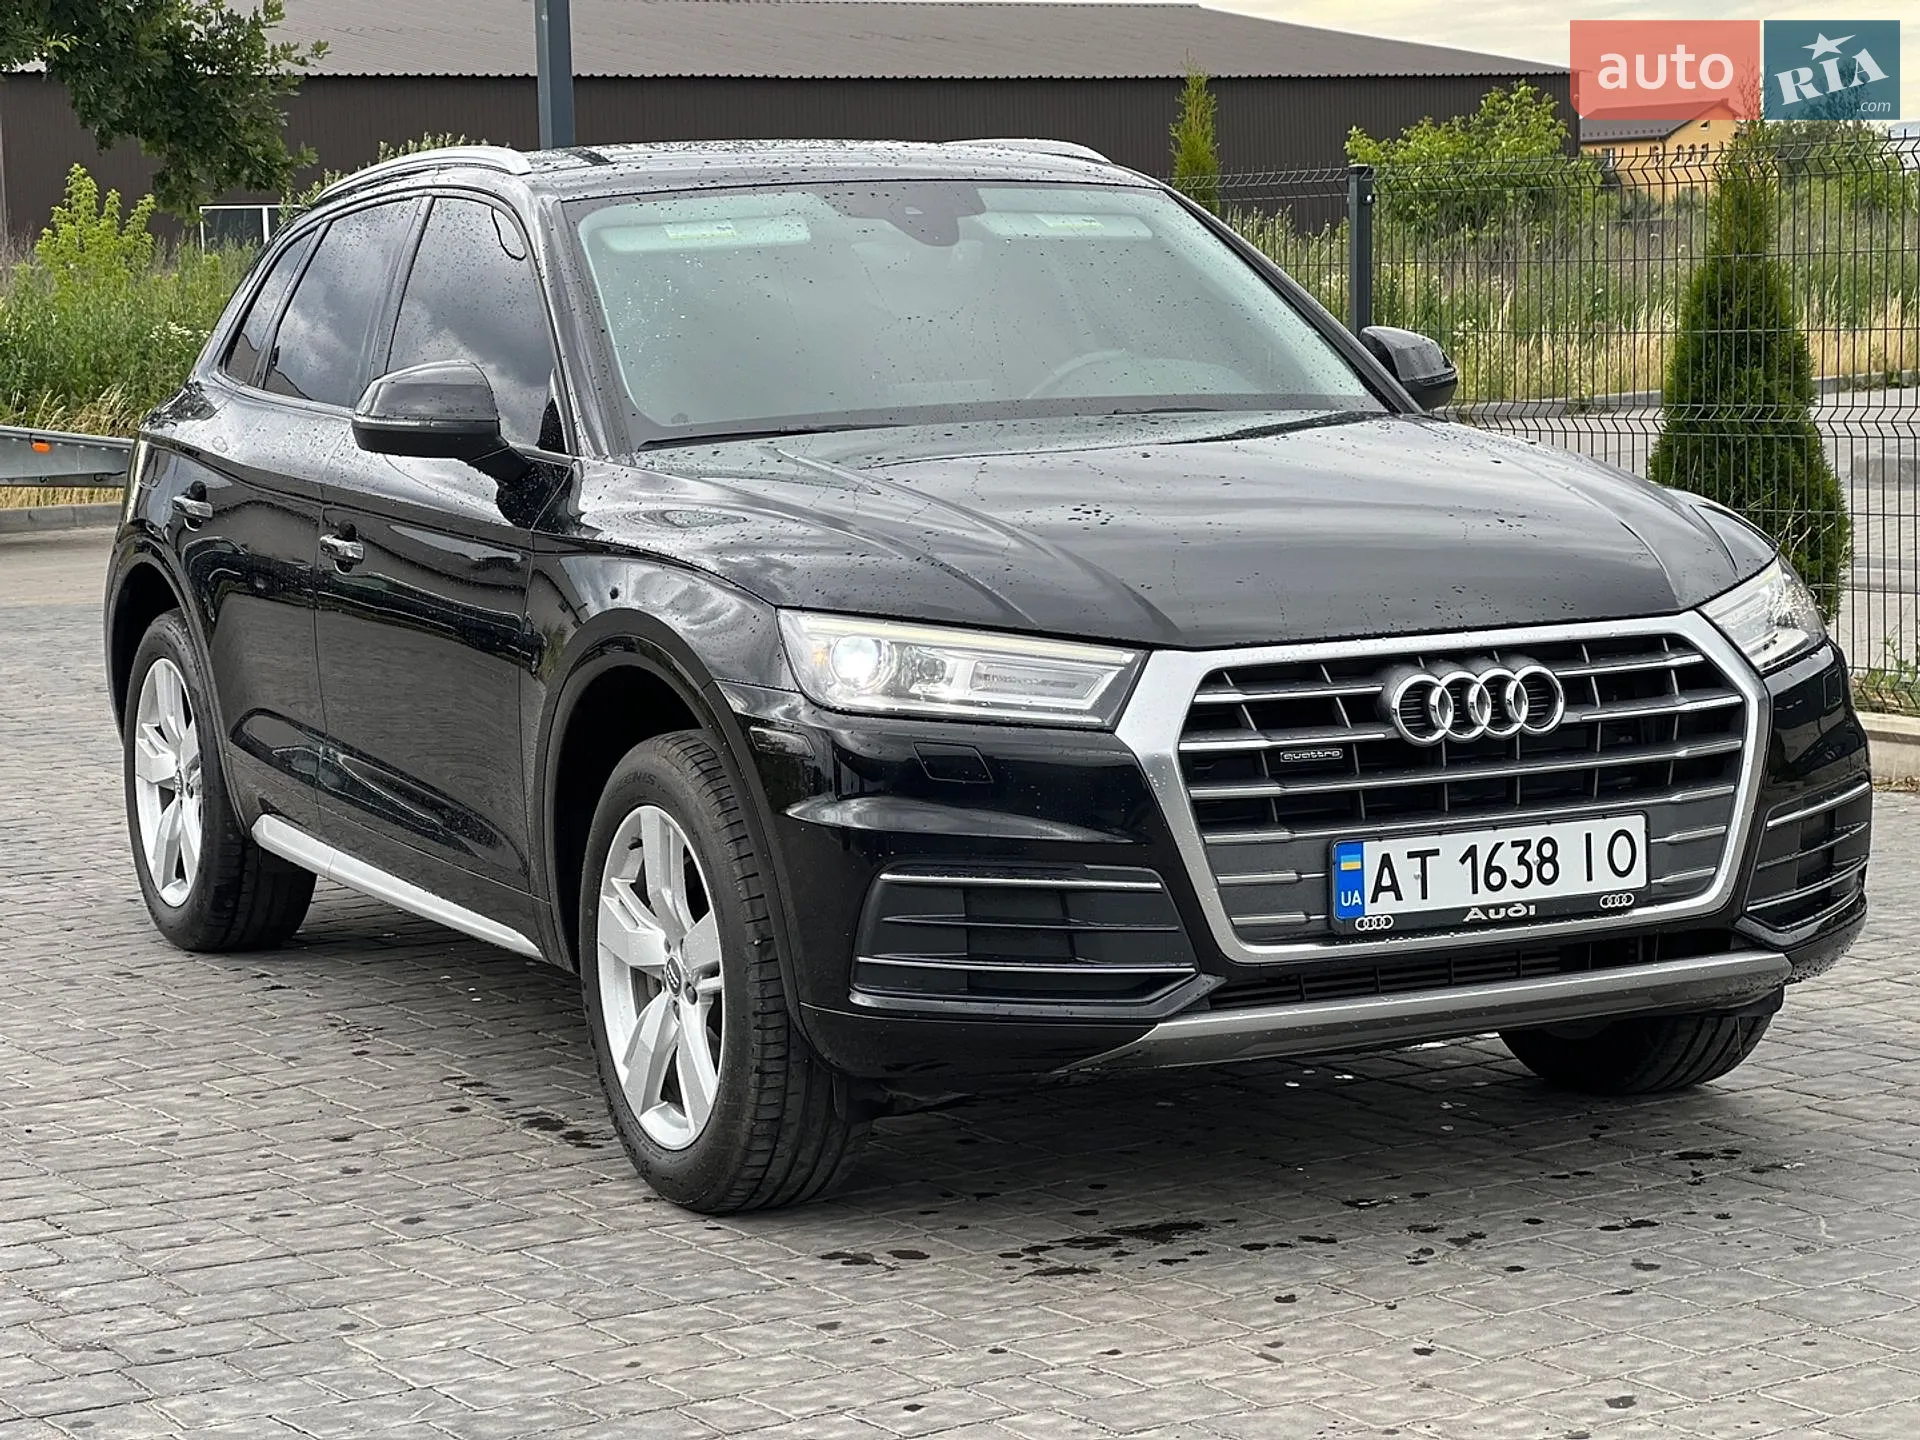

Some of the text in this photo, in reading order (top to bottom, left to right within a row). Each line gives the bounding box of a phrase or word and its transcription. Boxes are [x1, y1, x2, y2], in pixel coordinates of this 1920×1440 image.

[1283, 750, 1340, 760] quattro
[1370, 848, 1440, 903] AT
[1459, 836, 1560, 895] 1638
[1341, 890, 1362, 907] UA
[1463, 904, 1536, 922] Audi
